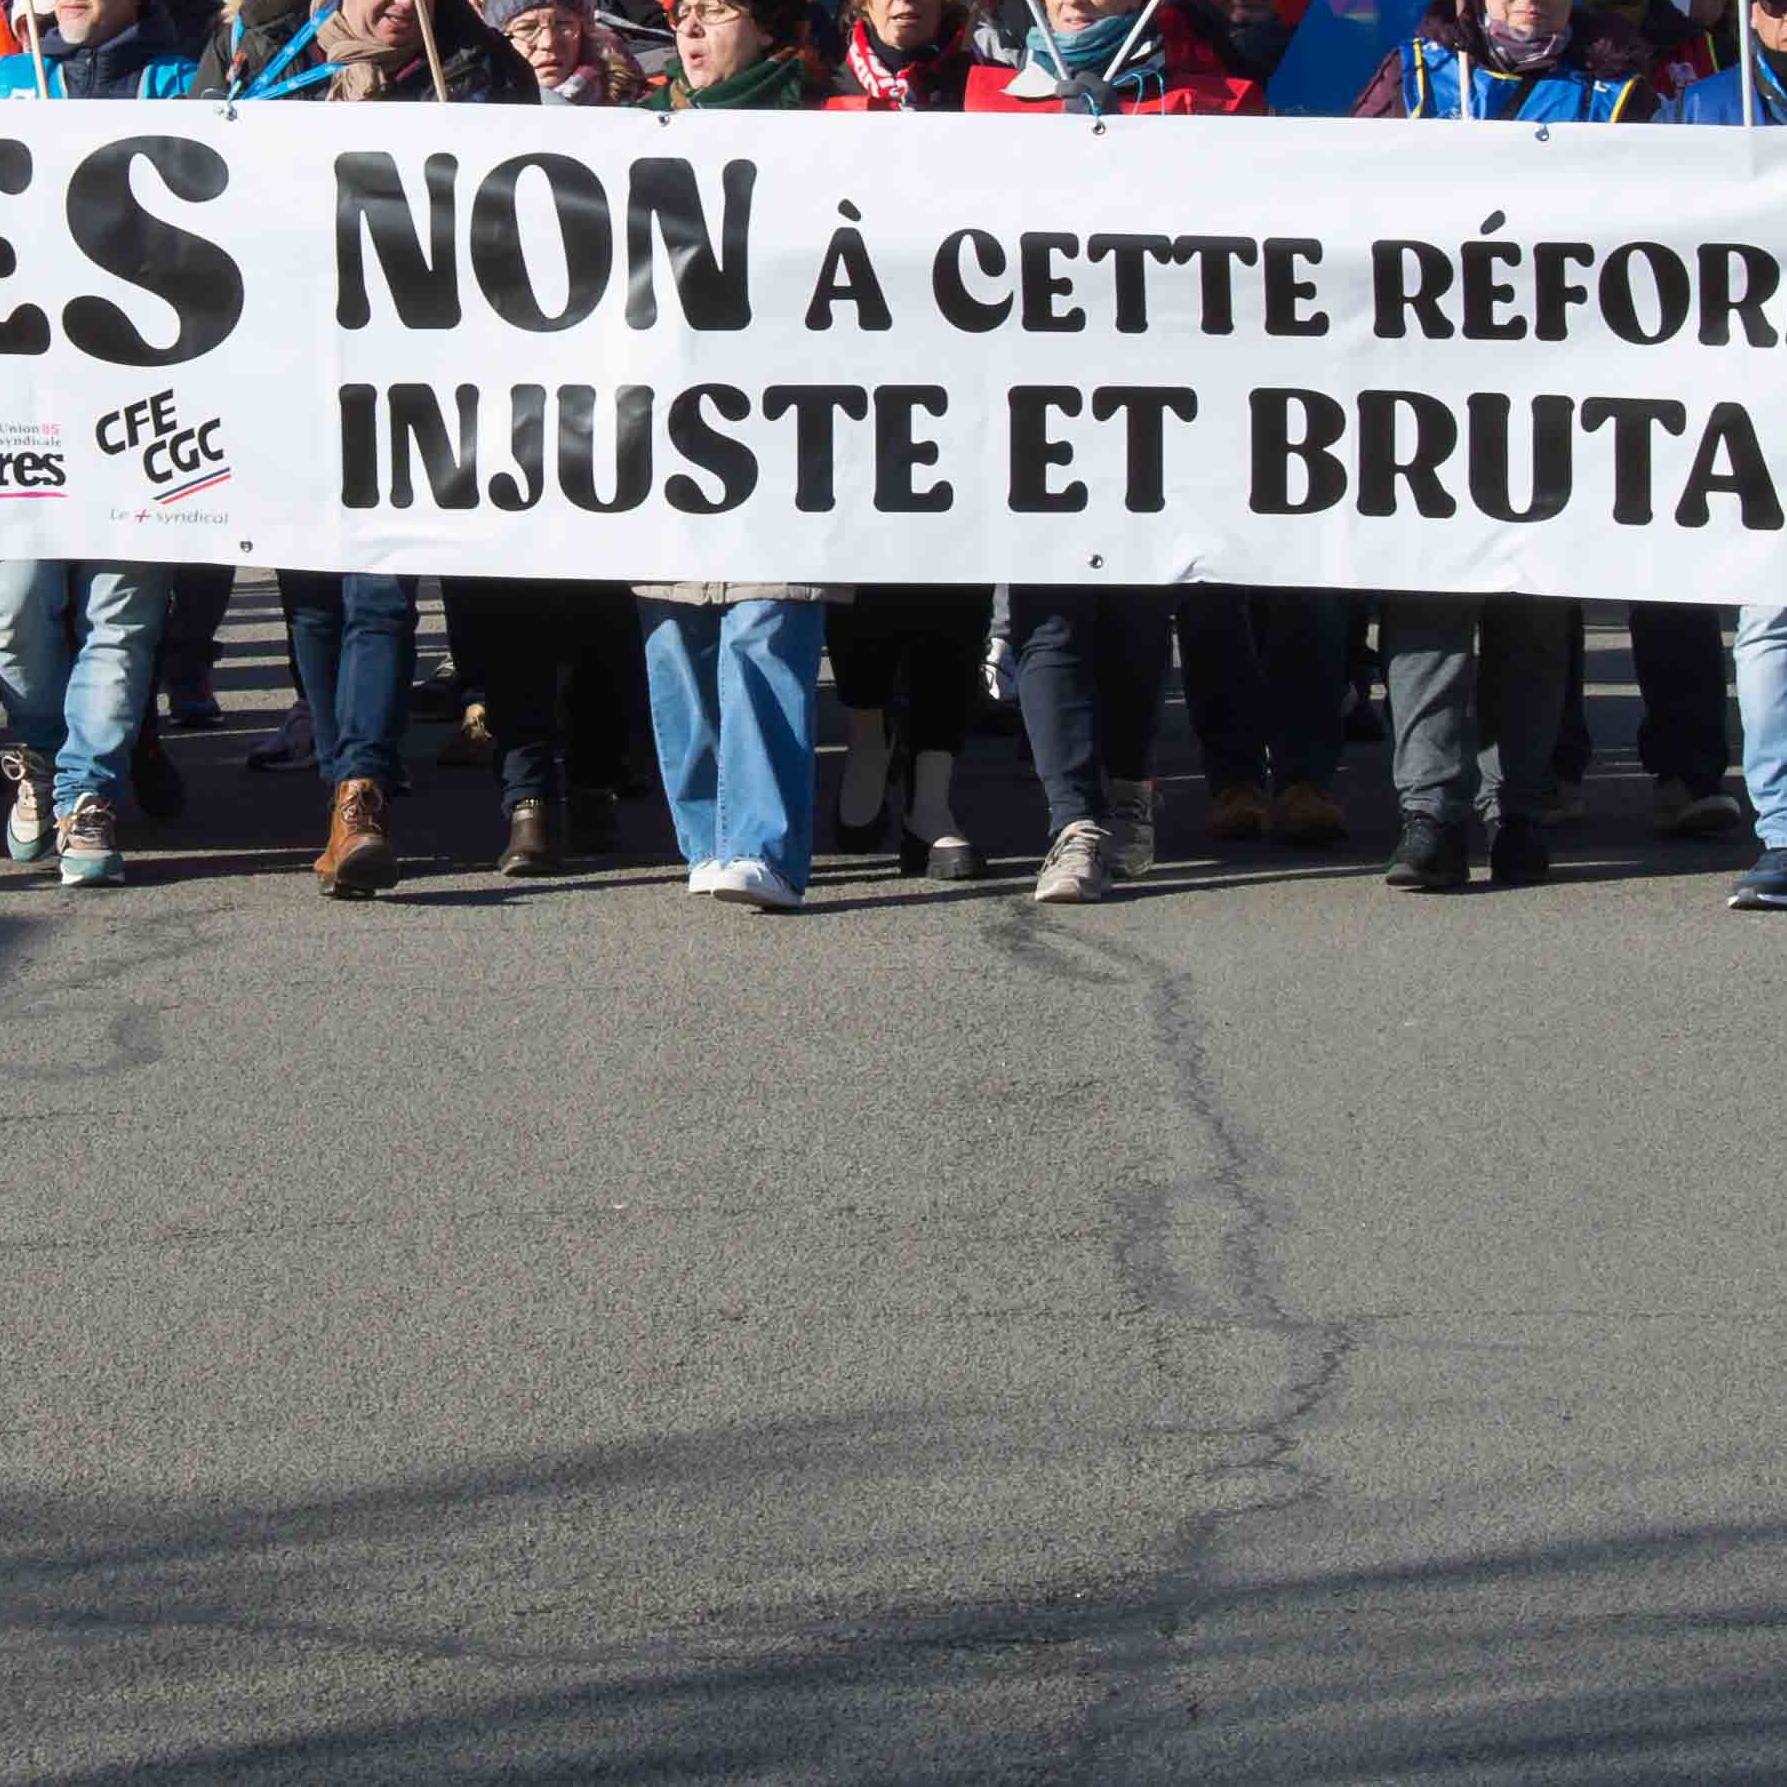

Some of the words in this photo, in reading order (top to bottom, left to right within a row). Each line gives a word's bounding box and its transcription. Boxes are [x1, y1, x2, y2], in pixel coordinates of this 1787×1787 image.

[335, 151, 757, 332] NON
[805, 199, 892, 332] À
[932, 227, 1329, 336] CETTE
[95, 388, 177, 455] CFE
[143, 417, 224, 484] CGC
[339, 383, 954, 514] INJUSTE
[1008, 385, 1198, 514] ET
[156, 509, 229, 525] syndical
